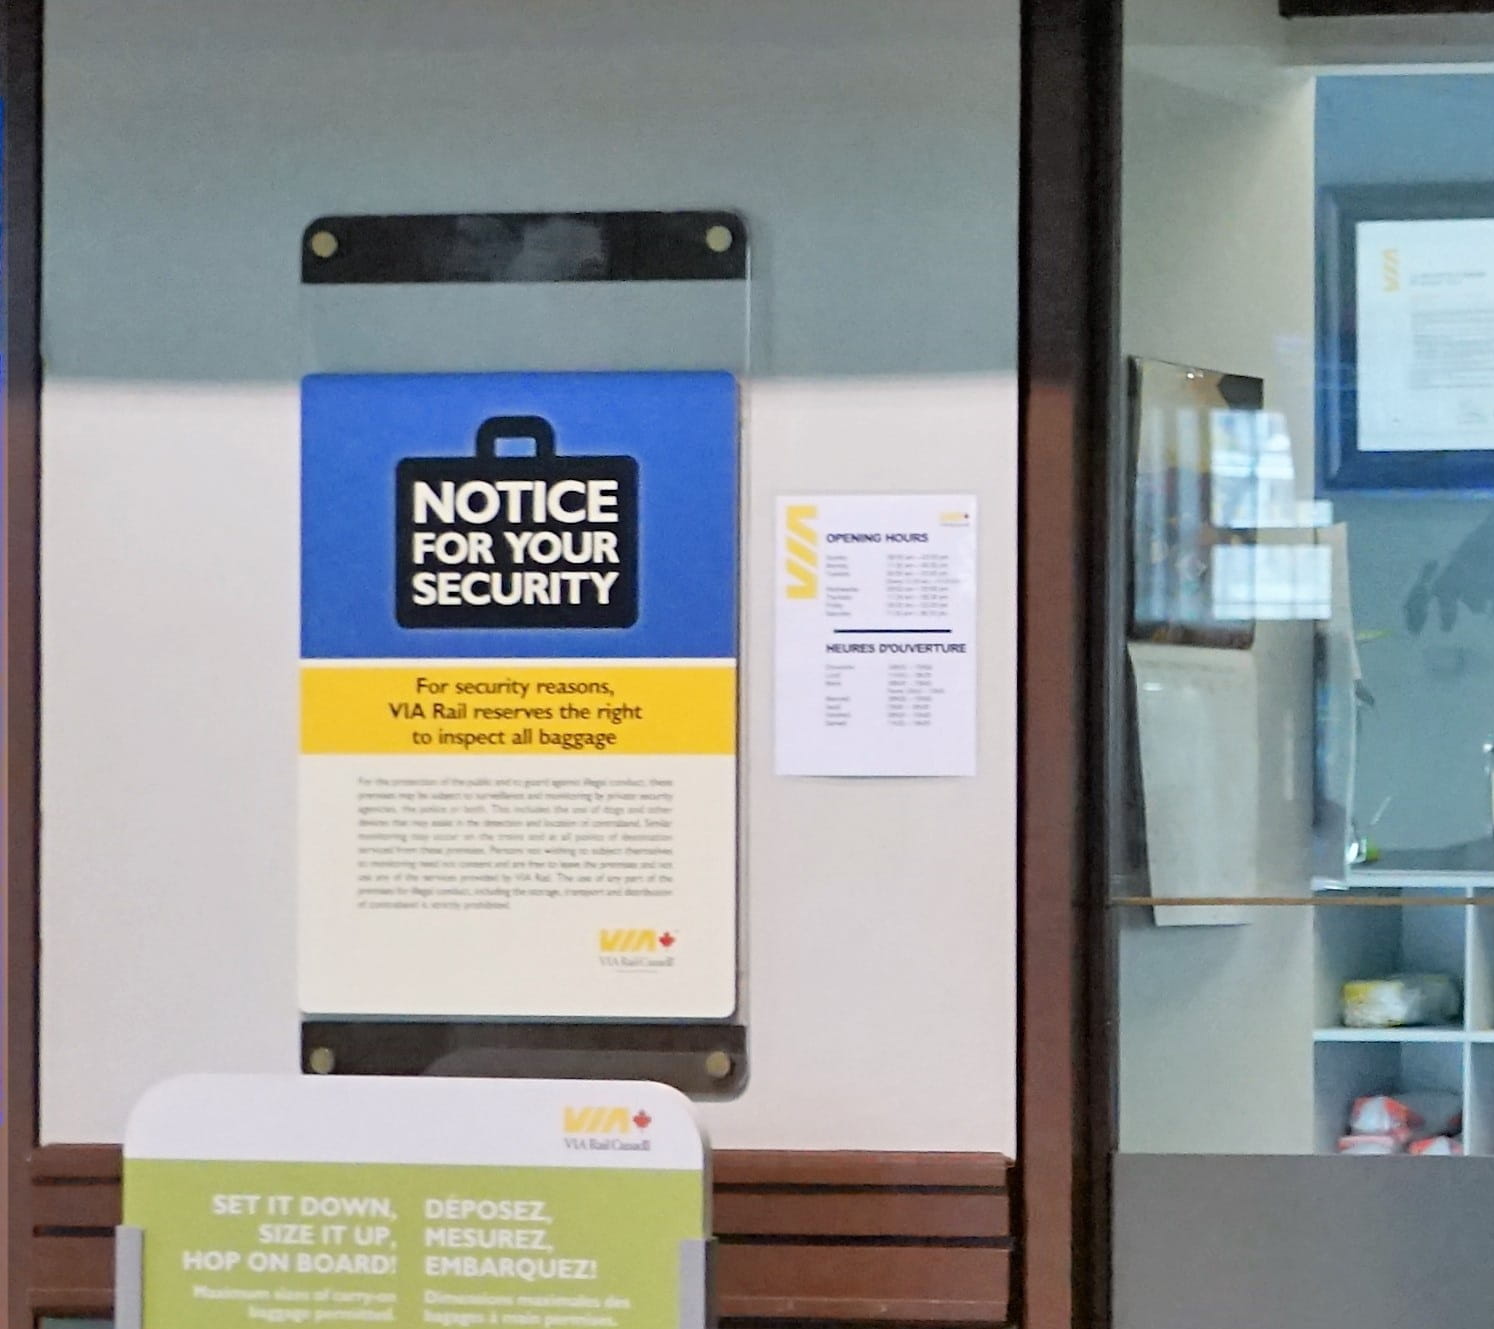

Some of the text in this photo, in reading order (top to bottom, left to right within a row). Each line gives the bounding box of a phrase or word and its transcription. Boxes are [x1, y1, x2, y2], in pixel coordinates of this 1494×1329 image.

[412, 479, 619, 525] NOTICE
[412, 531, 620, 565] FOR YOUR
[825, 533, 929, 544] OPENING HOURS
[412, 570, 619, 606] SECURITY
[825, 643, 967, 654] HEURES D'OUVERTURE
[416, 677, 616, 699] For security reasons,
[388, 702, 643, 725] VIA Rail reserves the right
[412, 728, 617, 751] to inspect all baggage
[599, 928, 657, 953] VIA
[564, 1107, 629, 1133] VIA
[213, 1195, 398, 1222] SET IT DOWN,
[424, 1194, 554, 1226] DÉPOSEZ,
[258, 1224, 397, 1250] SIZE IT UP,
[424, 1227, 555, 1254] MESUREZ,
[182, 1251, 398, 1276] HOP ON BOARD!
[424, 1255, 598, 1282] EMBARQUEZ!
